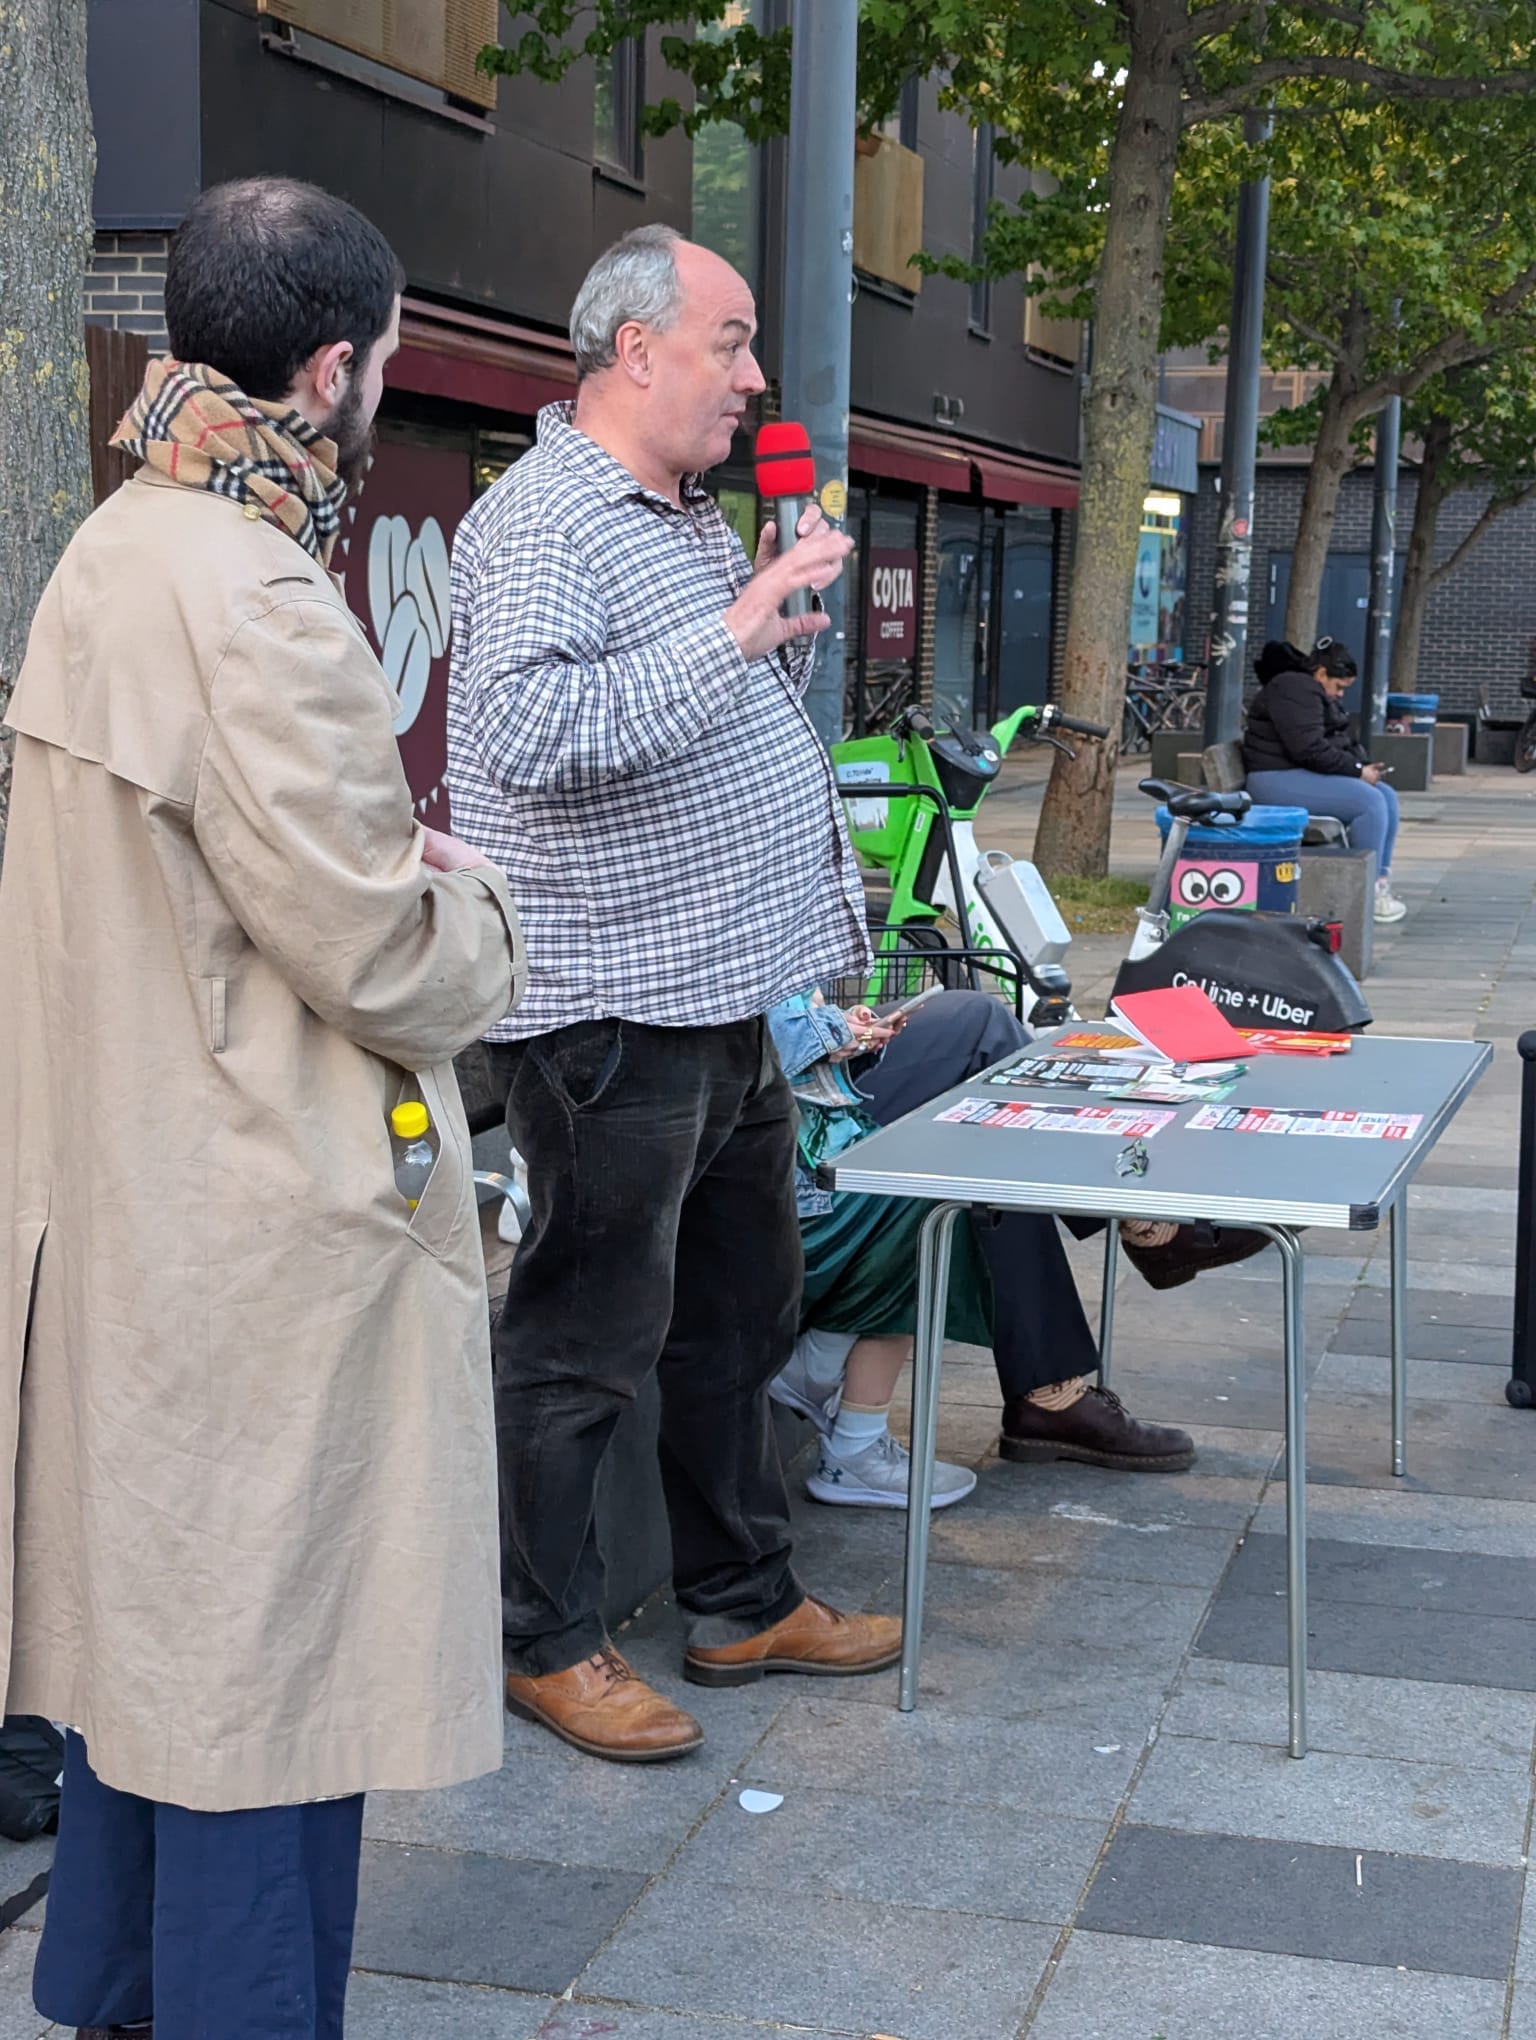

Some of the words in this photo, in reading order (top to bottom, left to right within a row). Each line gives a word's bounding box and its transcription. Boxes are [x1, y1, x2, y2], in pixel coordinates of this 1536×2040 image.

[872, 567, 913, 614] COSTA
[881, 621, 904, 639] COFFEE
[1262, 993, 1314, 1026] Uber
